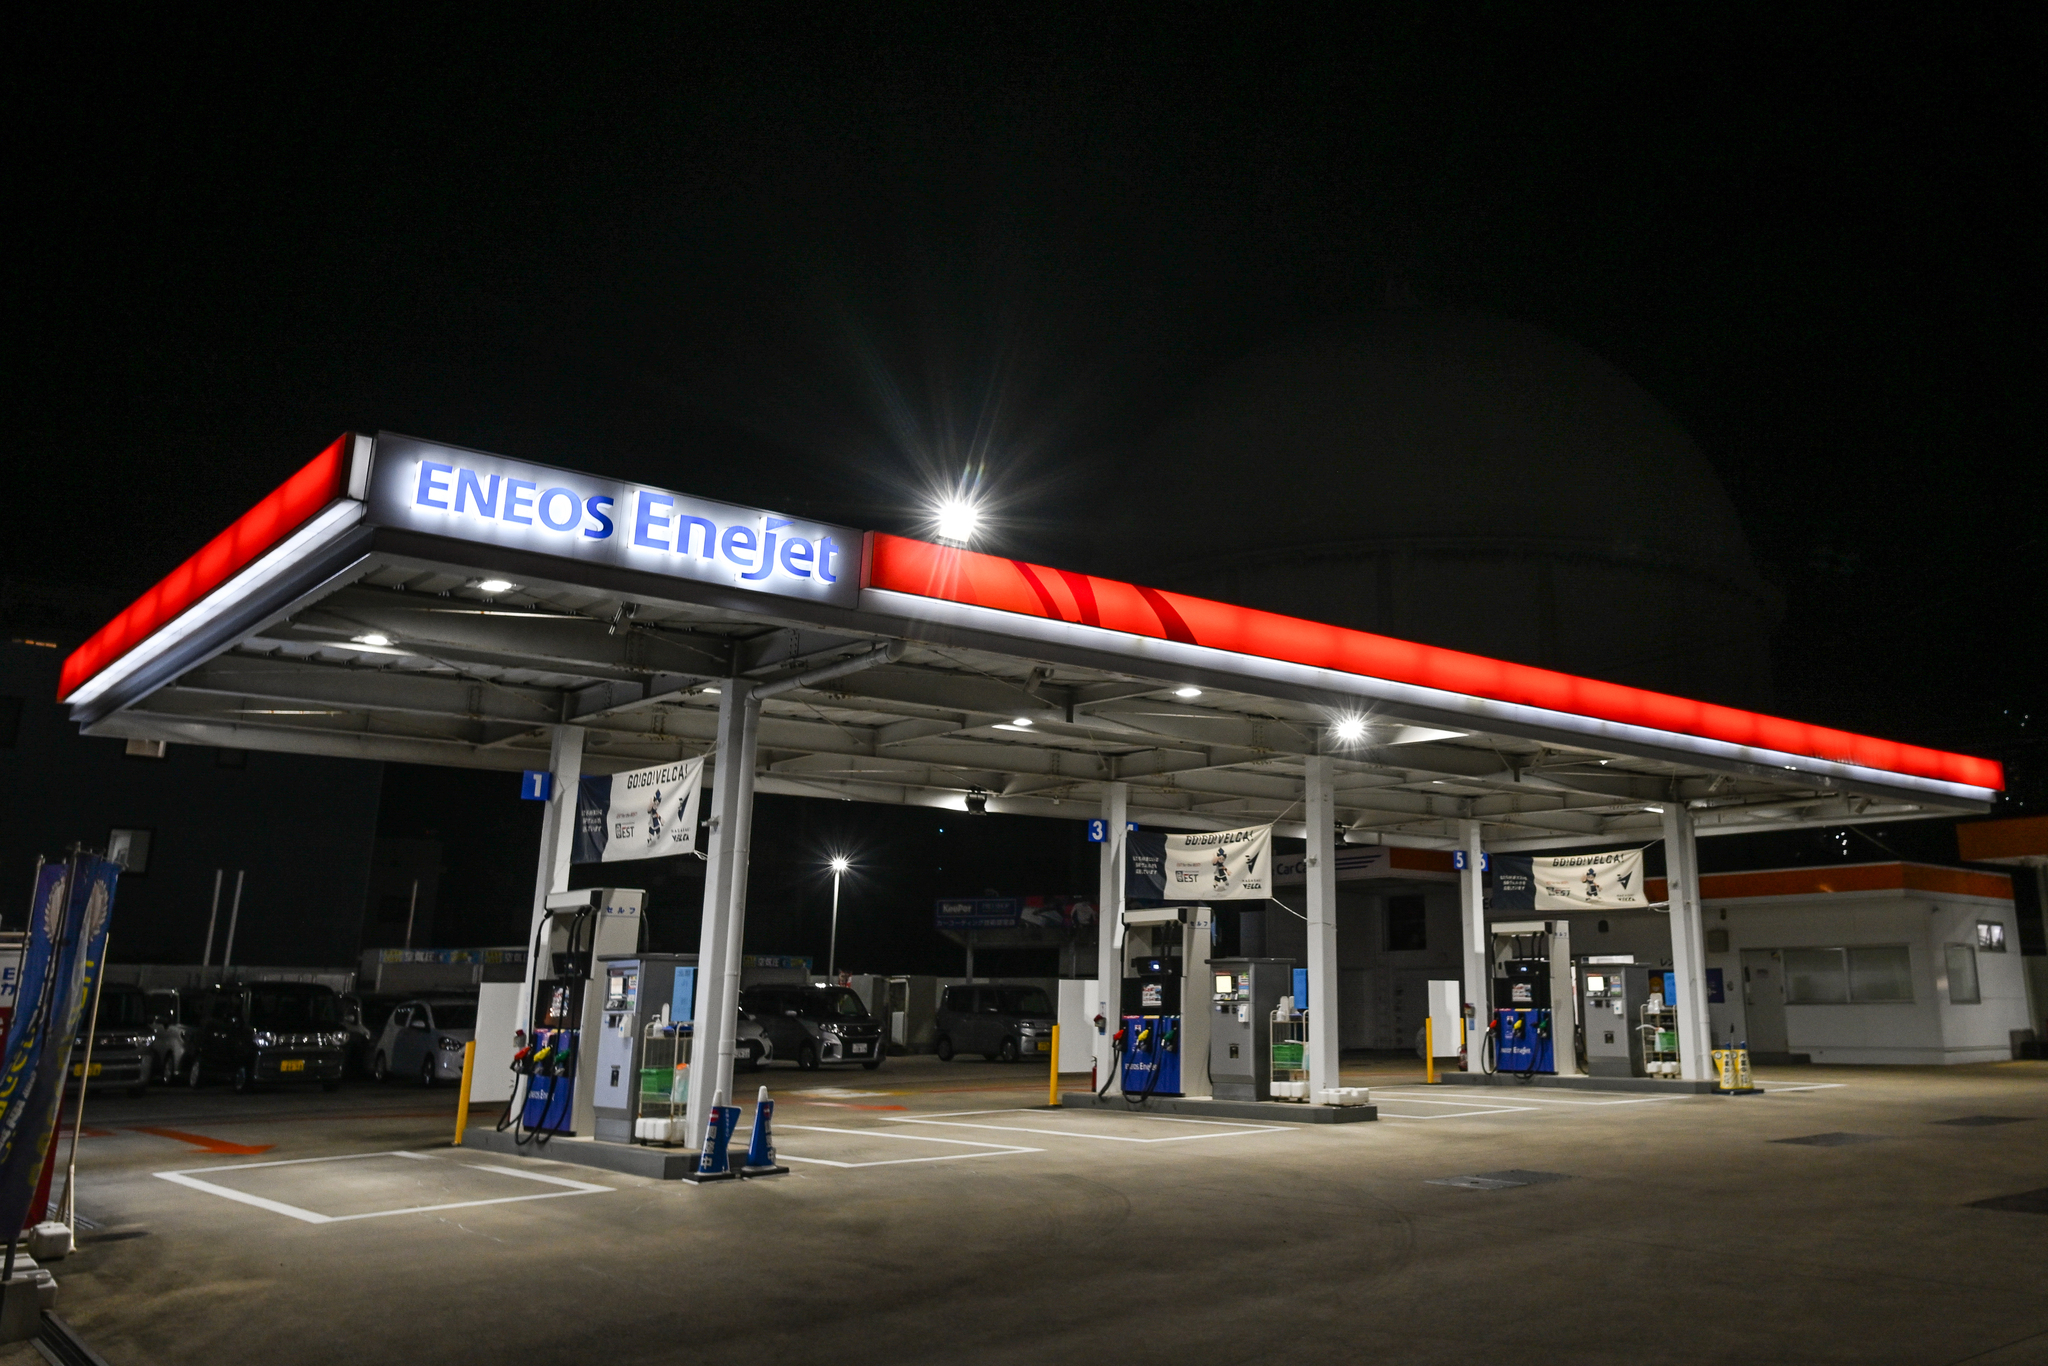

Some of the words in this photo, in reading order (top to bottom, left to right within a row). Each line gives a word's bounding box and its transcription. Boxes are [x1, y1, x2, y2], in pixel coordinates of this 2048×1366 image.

[416, 459, 615, 540] ENEOS
[631, 490, 839, 584] Enejet
[532, 773, 543, 797] 1
[1091, 820, 1103, 839] 3
[1456, 852, 1464, 868] 5
[1277, 863, 1294, 875] Car
[606, 905, 636, 914] セルフ
